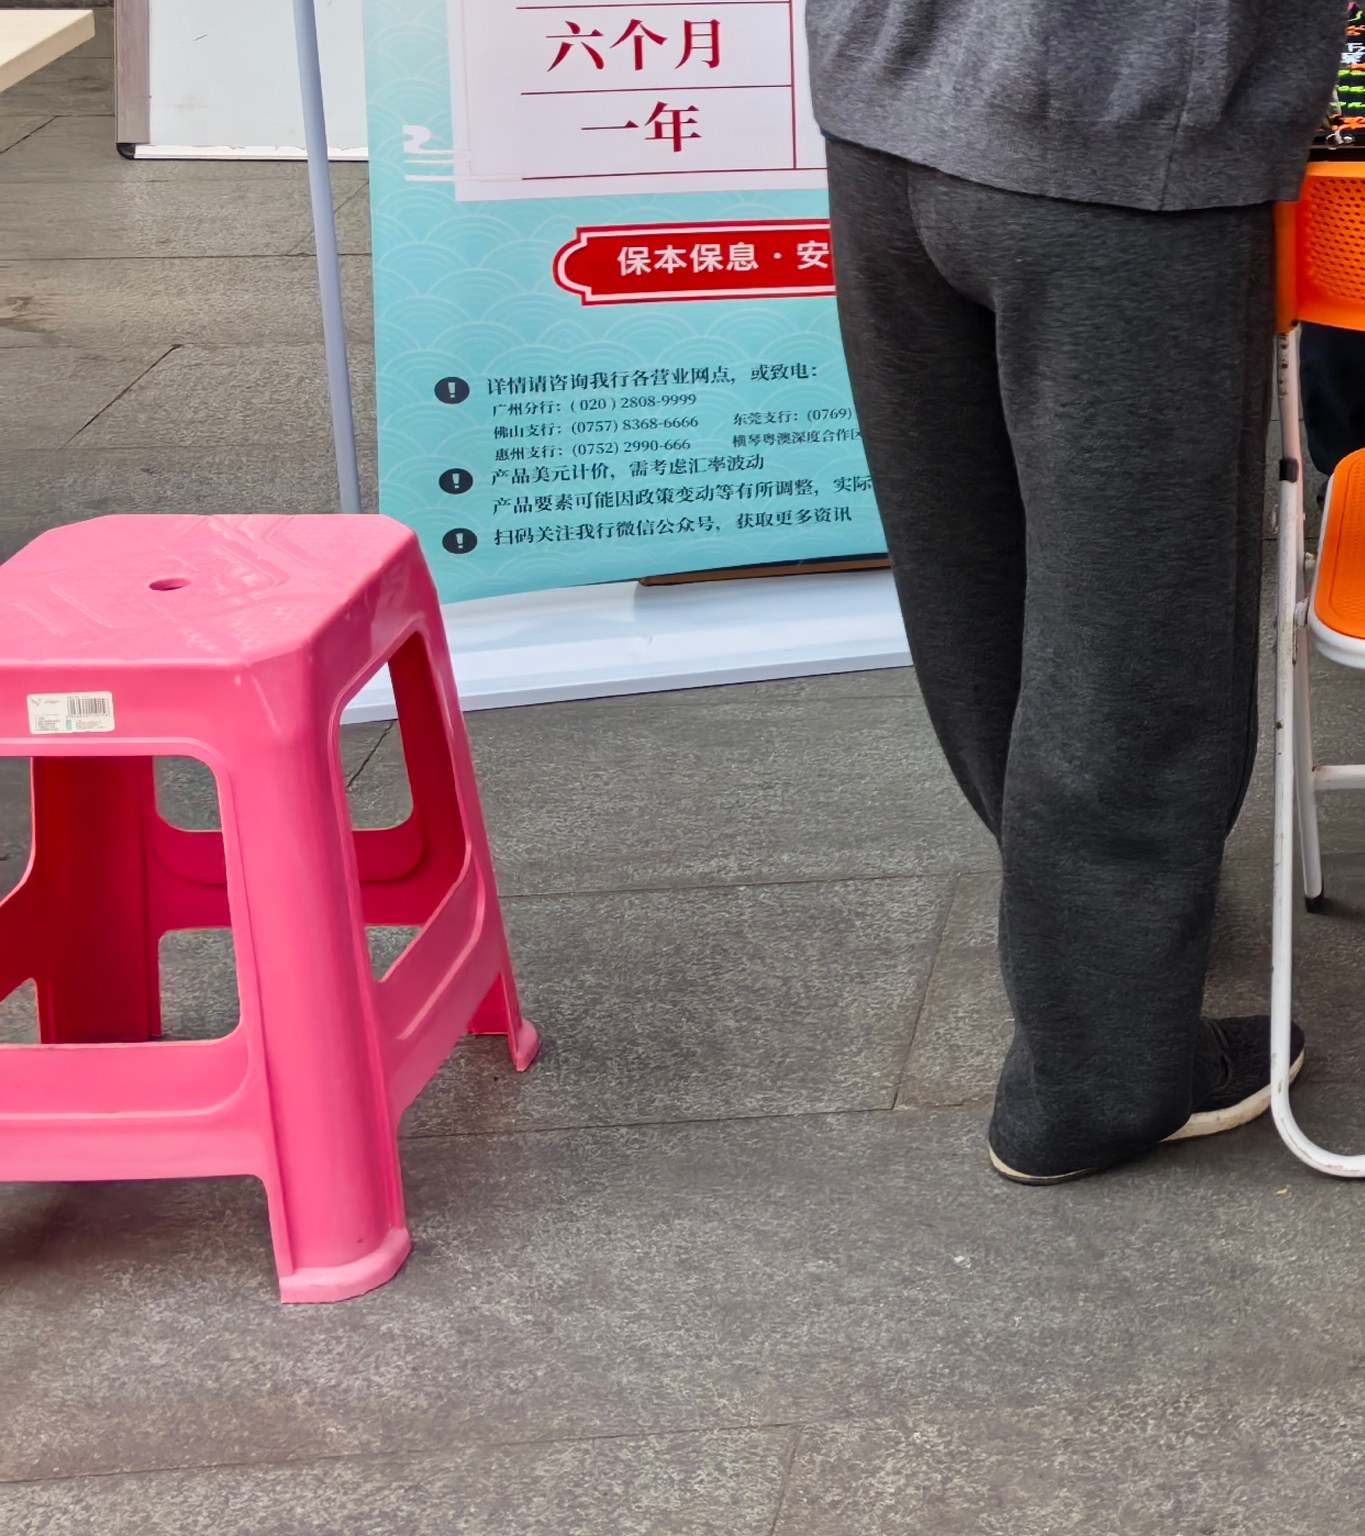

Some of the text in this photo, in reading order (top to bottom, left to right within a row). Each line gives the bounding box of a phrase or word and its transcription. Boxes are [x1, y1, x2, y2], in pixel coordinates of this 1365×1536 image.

[546, 18, 722, 72] 六个月
[580, 101, 702, 154] 一年
[616, 238, 829, 277] 保本保息·安
[492, 400, 561, 417] 广州分行：
[620, 394, 697, 409] 2808-9999
[733, 407, 852, 426] 东莞支行： (0769)
[494, 416, 699, 440] 佛山支行： (0757) 8368-6666
[495, 438, 691, 461] 惠州支行： (0752) 2990-666
